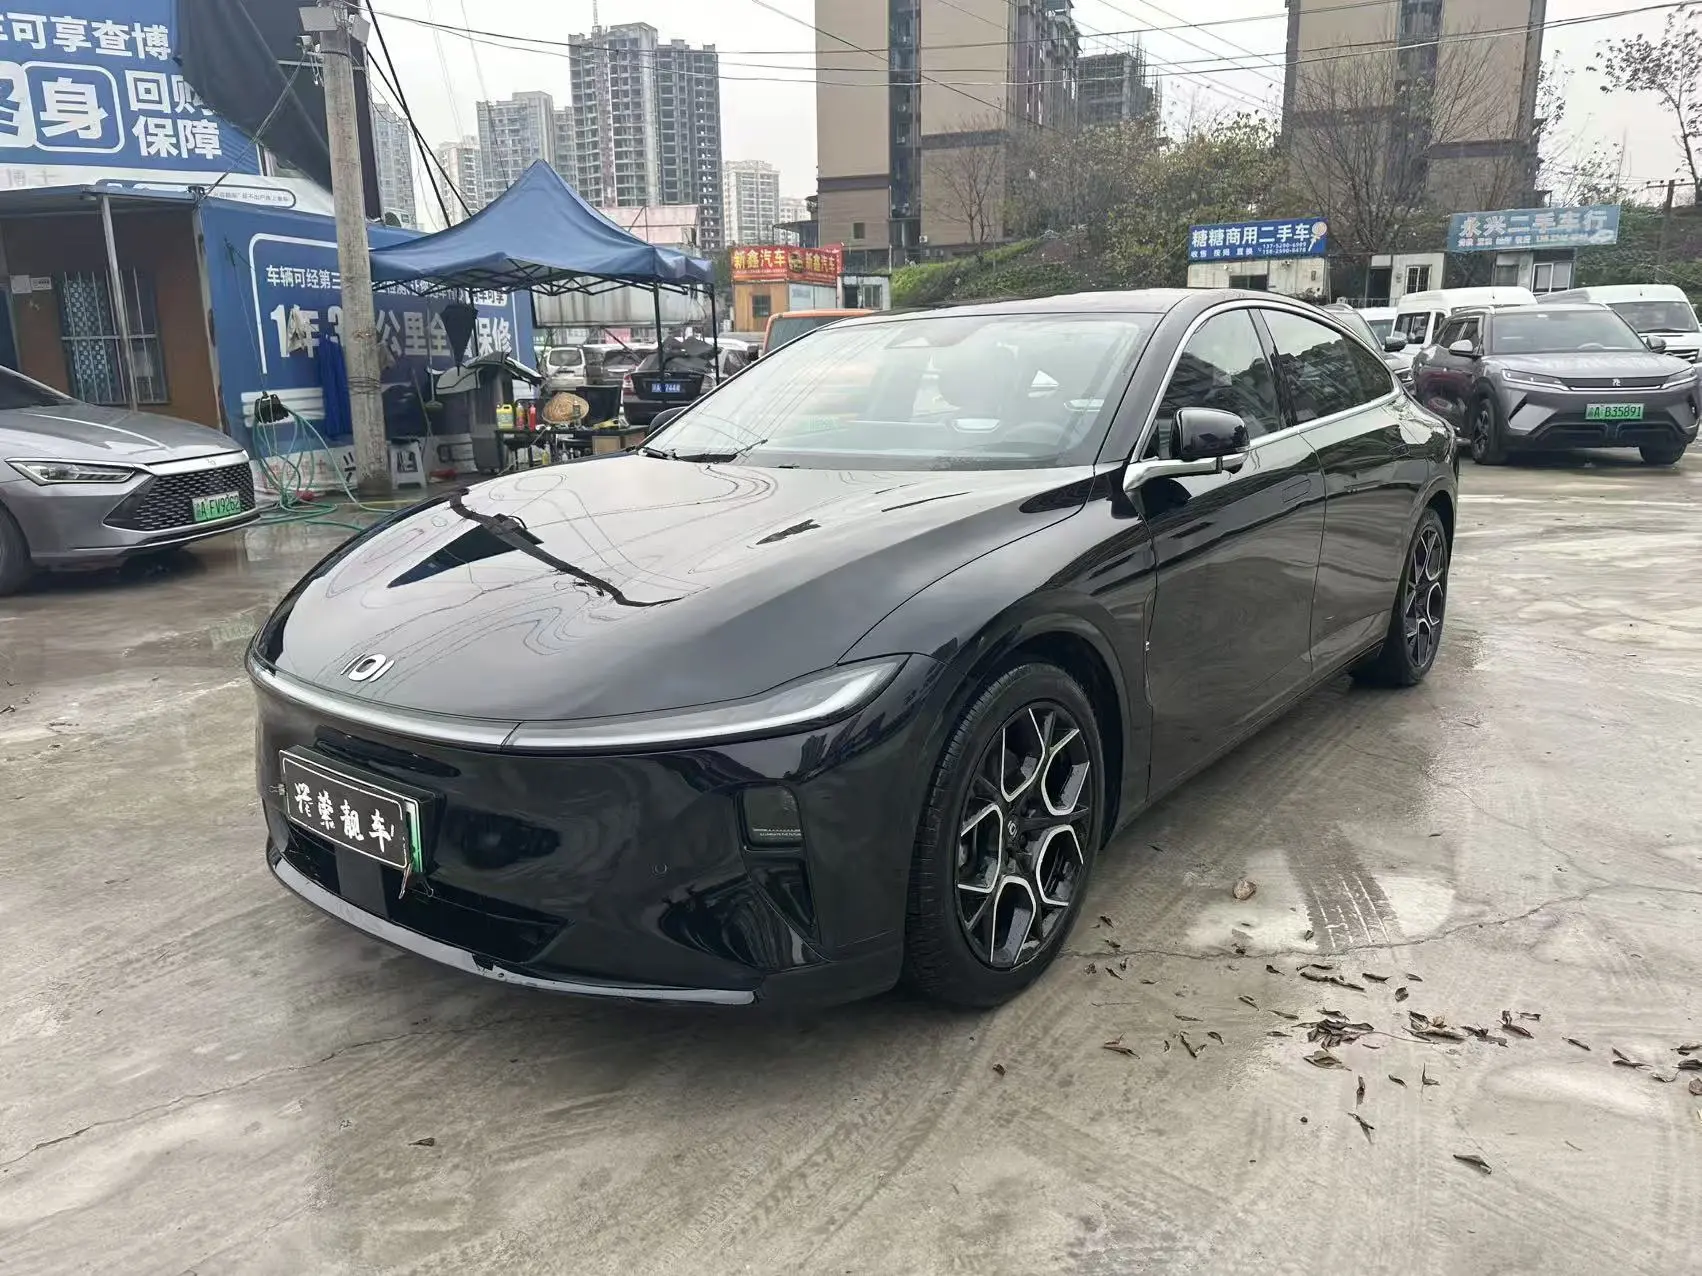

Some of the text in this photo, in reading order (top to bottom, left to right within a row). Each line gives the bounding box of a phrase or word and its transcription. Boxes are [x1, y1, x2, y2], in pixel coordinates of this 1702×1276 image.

[131, 115, 223, 160] 保障
[1192, 223, 1310, 247] 糖糖商用二手车
[734, 249, 785, 269] 新鑫汽车
